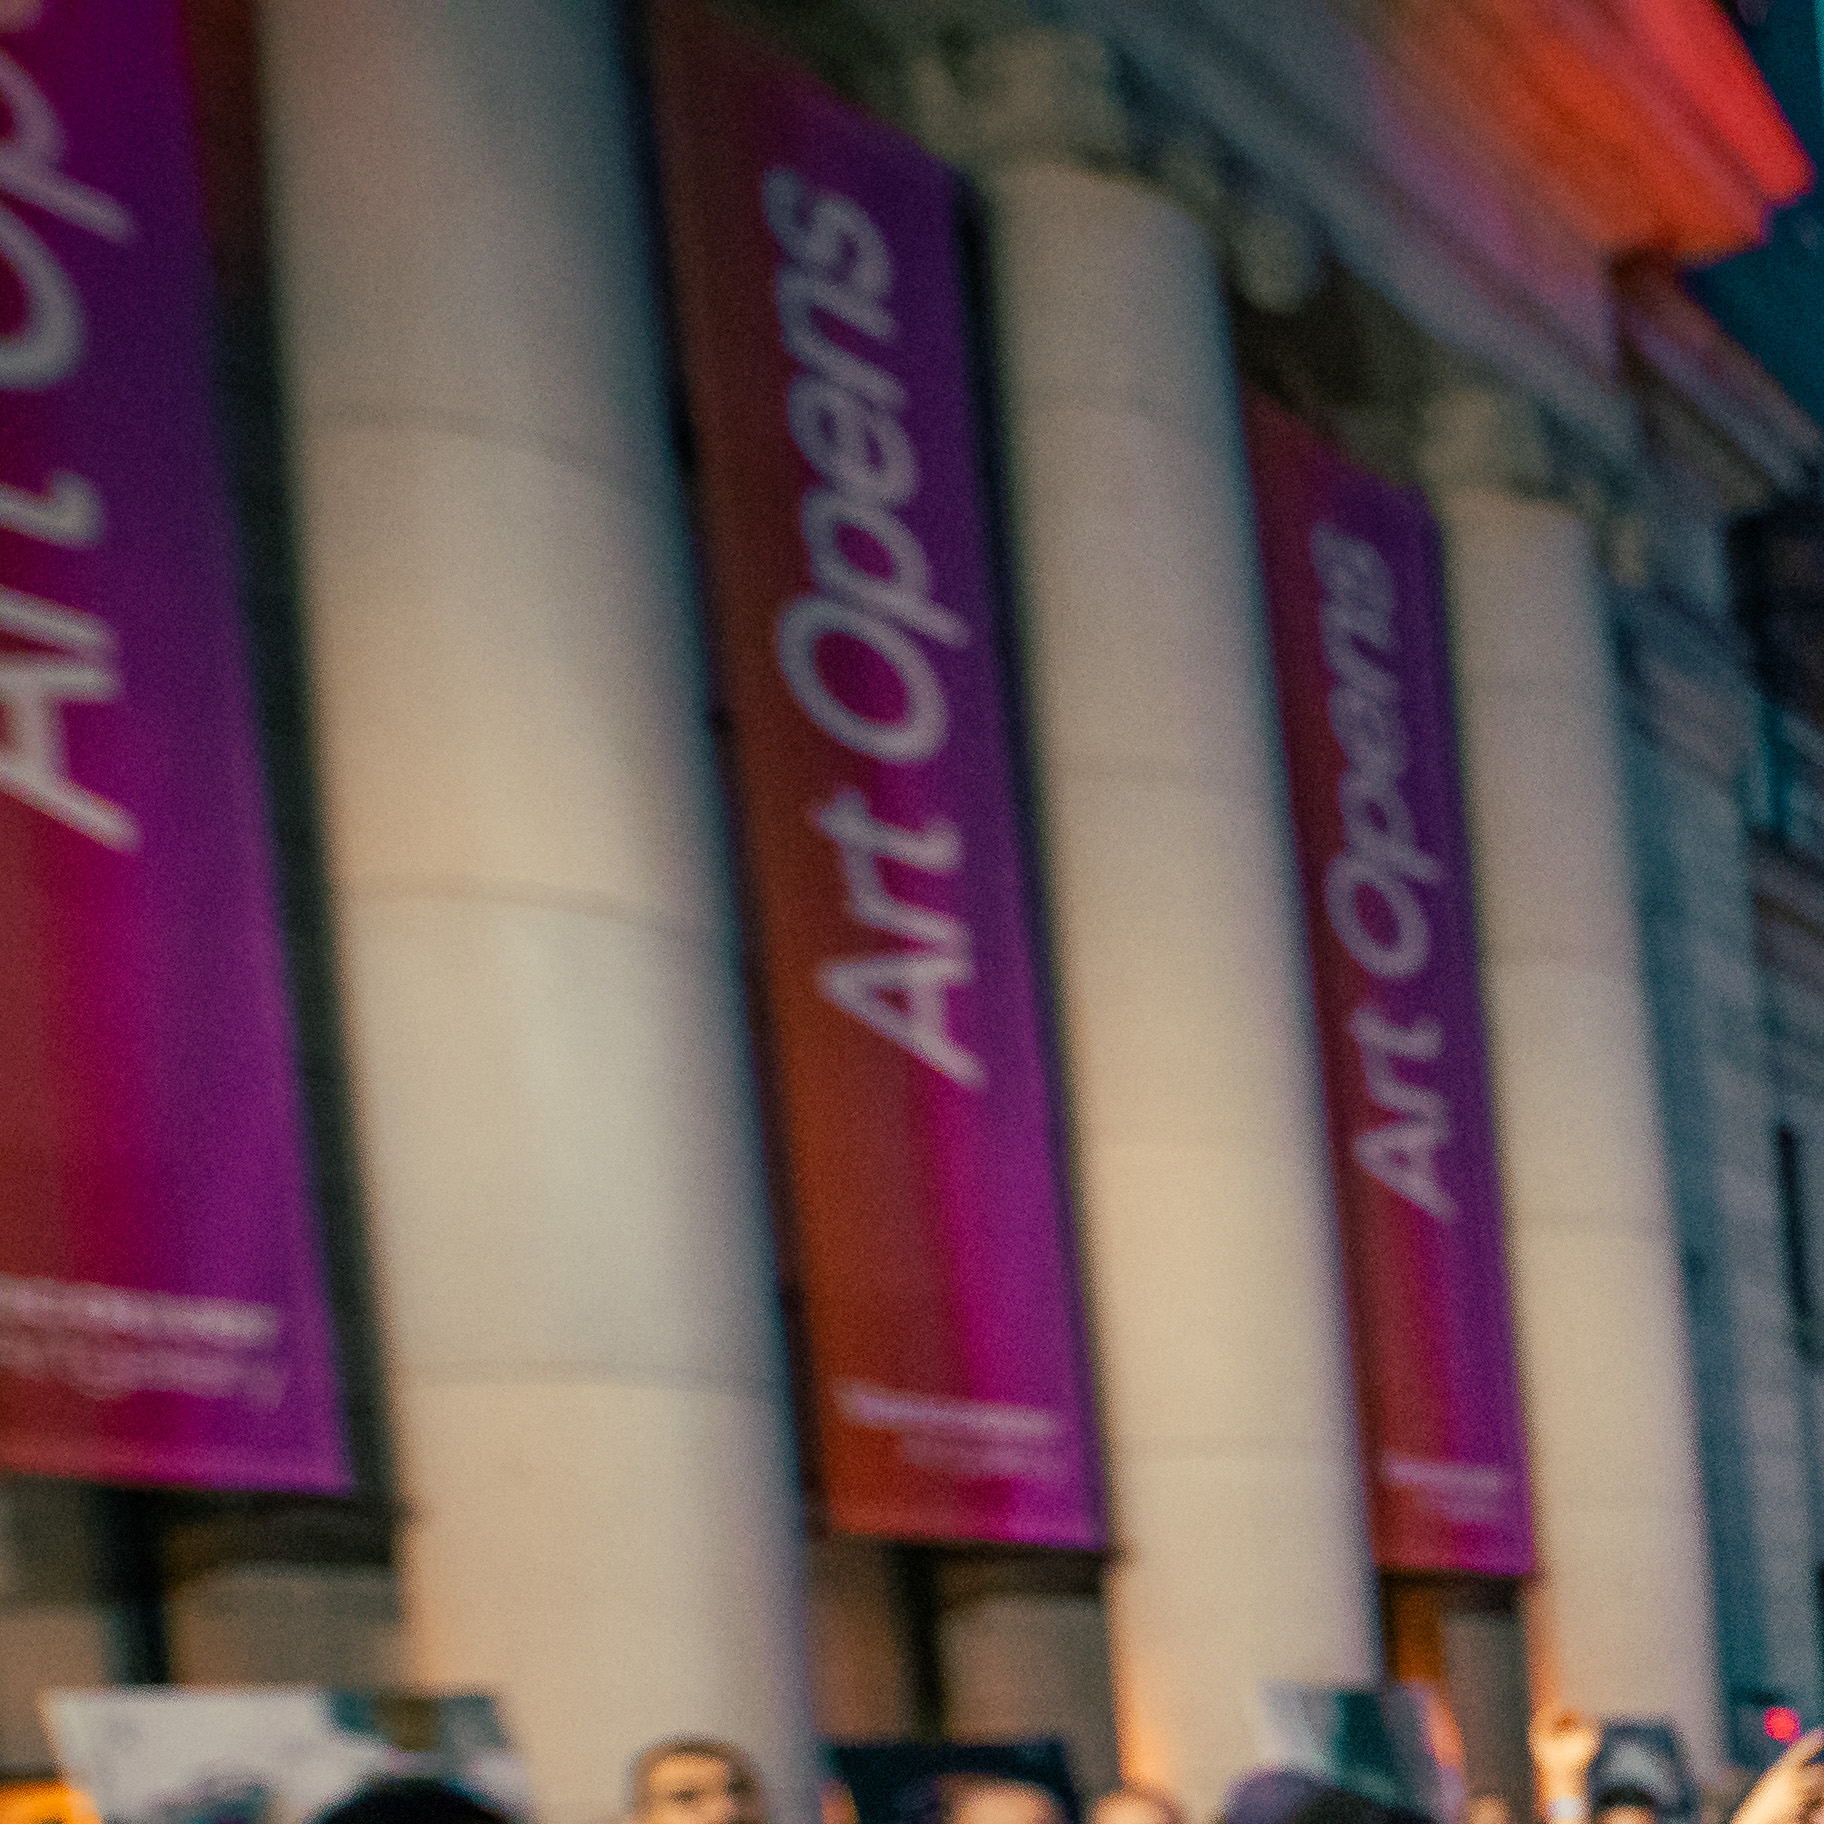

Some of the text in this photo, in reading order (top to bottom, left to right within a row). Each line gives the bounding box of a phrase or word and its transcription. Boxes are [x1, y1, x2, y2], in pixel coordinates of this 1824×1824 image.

[762, 166, 987, 1090] Art Opens
[1311, 522, 1460, 1225] Art Opens
